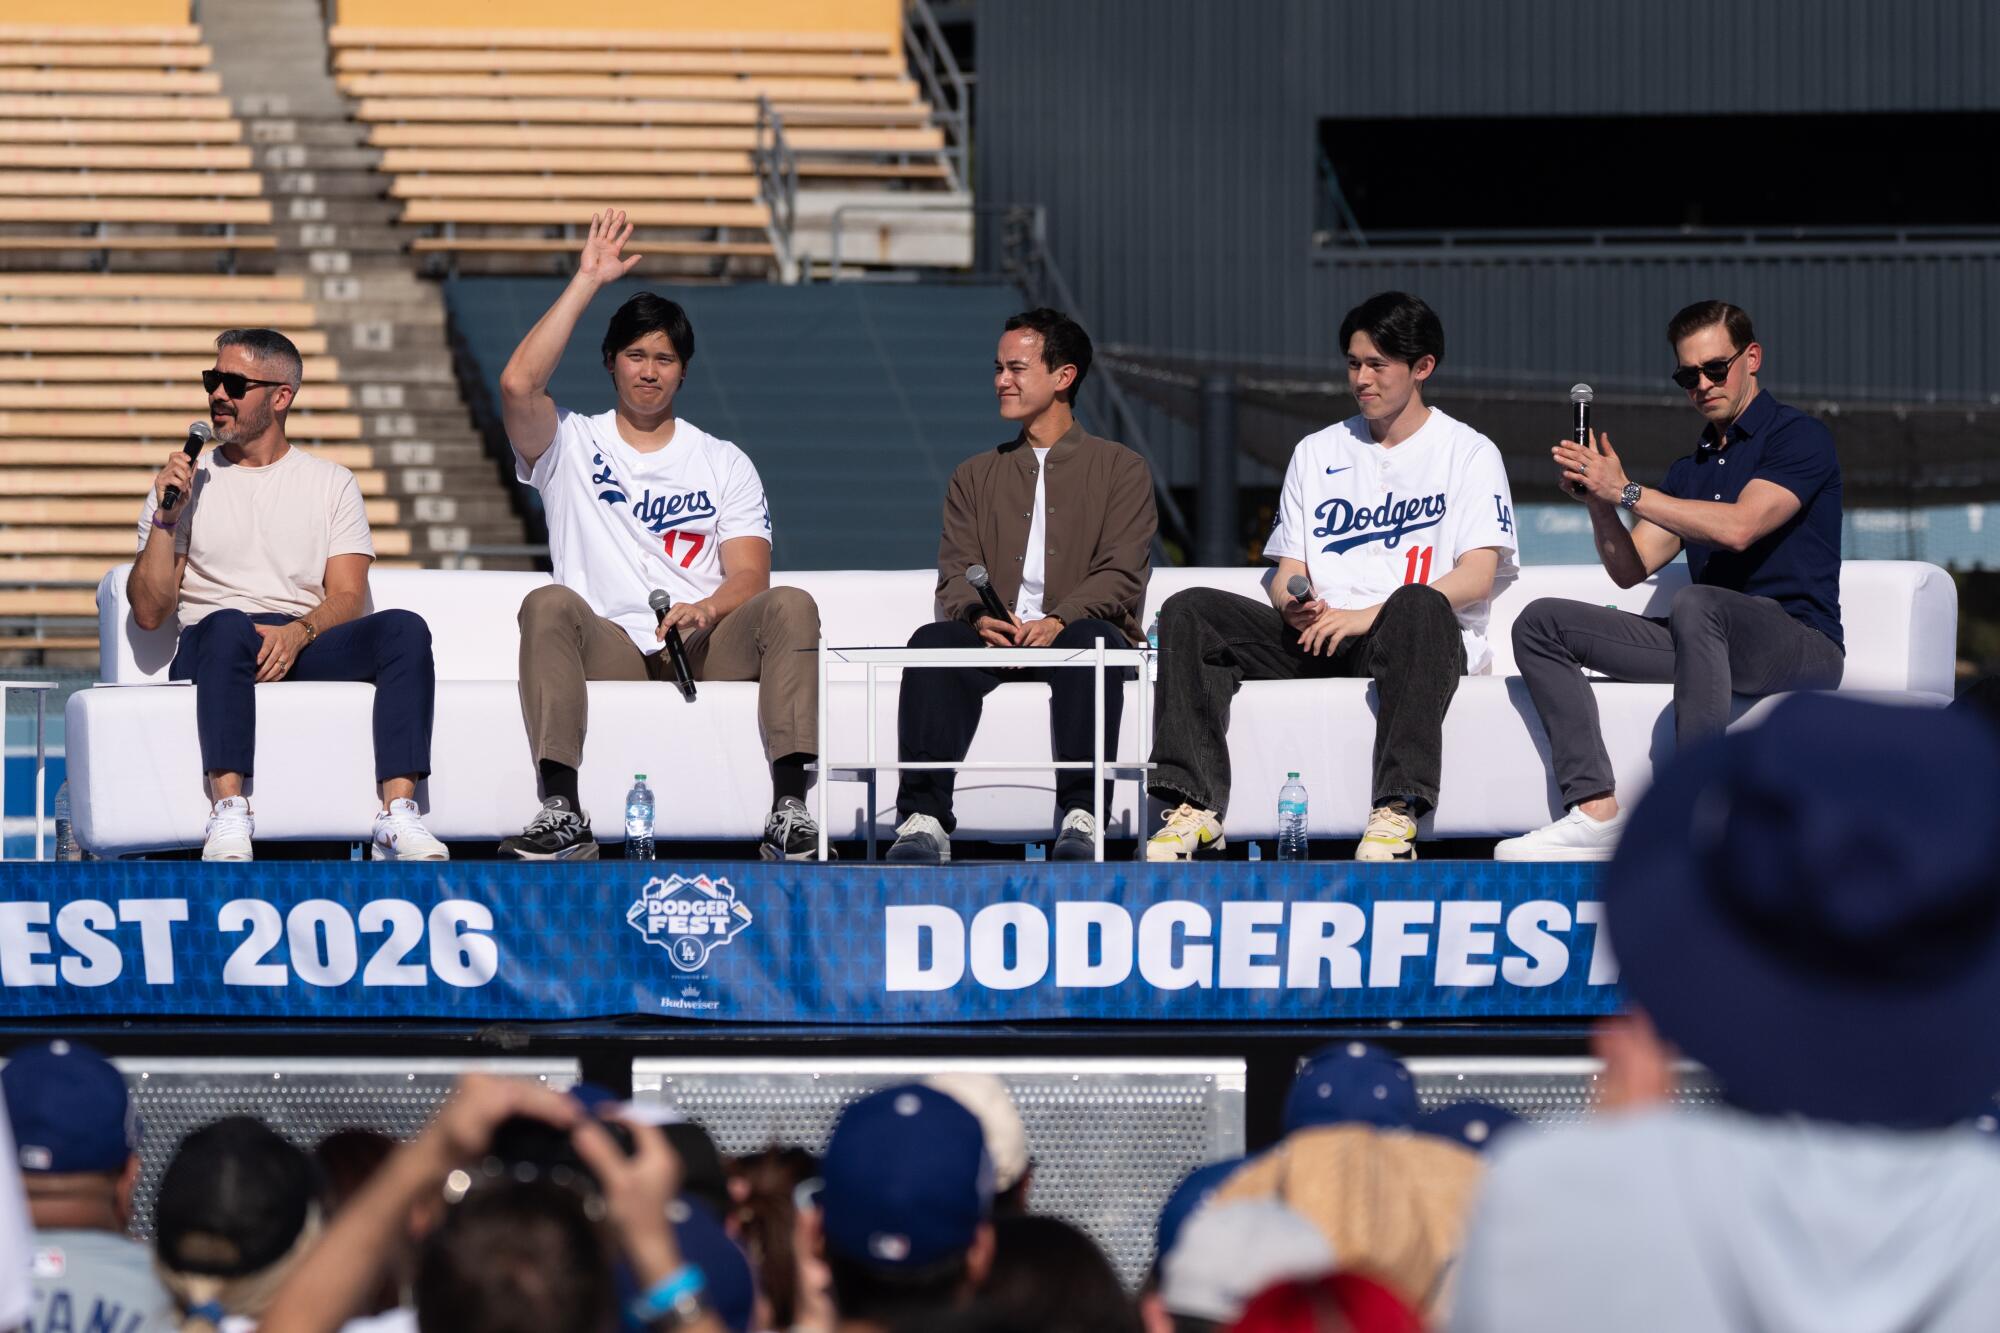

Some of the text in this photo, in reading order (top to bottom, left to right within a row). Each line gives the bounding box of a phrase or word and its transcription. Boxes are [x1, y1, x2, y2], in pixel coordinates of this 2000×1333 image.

[1313, 492, 1446, 555] Dodgers
[1494, 494, 1514, 536] LA
[663, 530, 705, 569] 17
[1404, 545, 1433, 586] 11
[648, 916, 730, 934] FEST
[649, 900, 729, 915] DODGER
[0, 898, 498, 987] EST 2026
[681, 941, 696, 961] LA
[661, 997, 720, 1010] Budweiser
